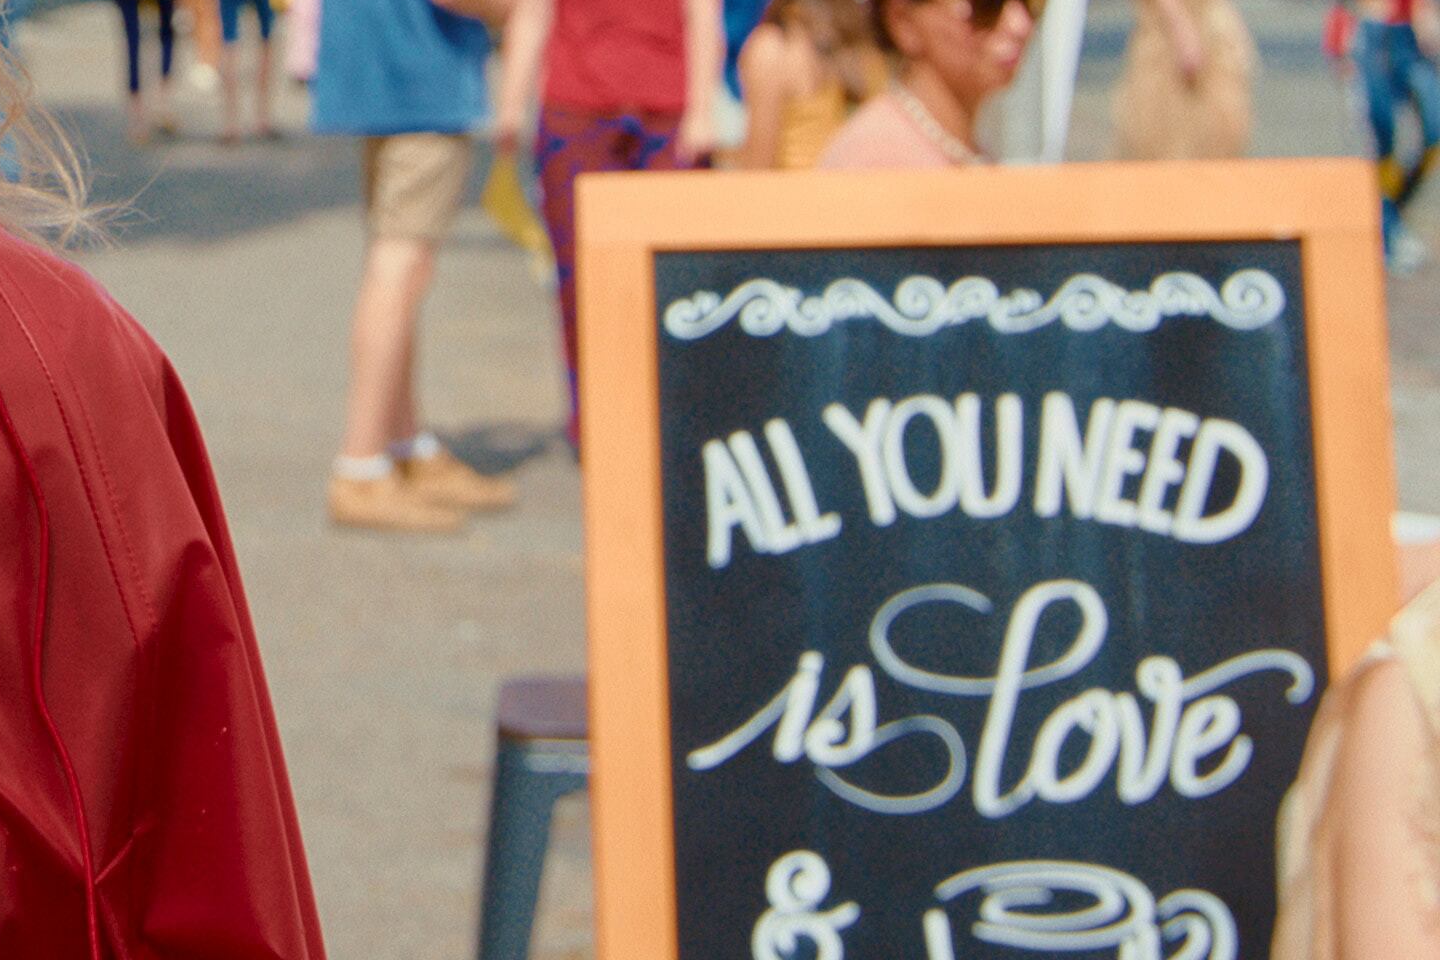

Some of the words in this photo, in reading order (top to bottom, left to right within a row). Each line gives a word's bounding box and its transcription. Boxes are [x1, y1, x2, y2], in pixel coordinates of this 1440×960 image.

[702, 417, 843, 568] ALL
[821, 391, 1025, 527] YOU
[1032, 390, 1269, 544] NEED
[686, 650, 967, 814] is
